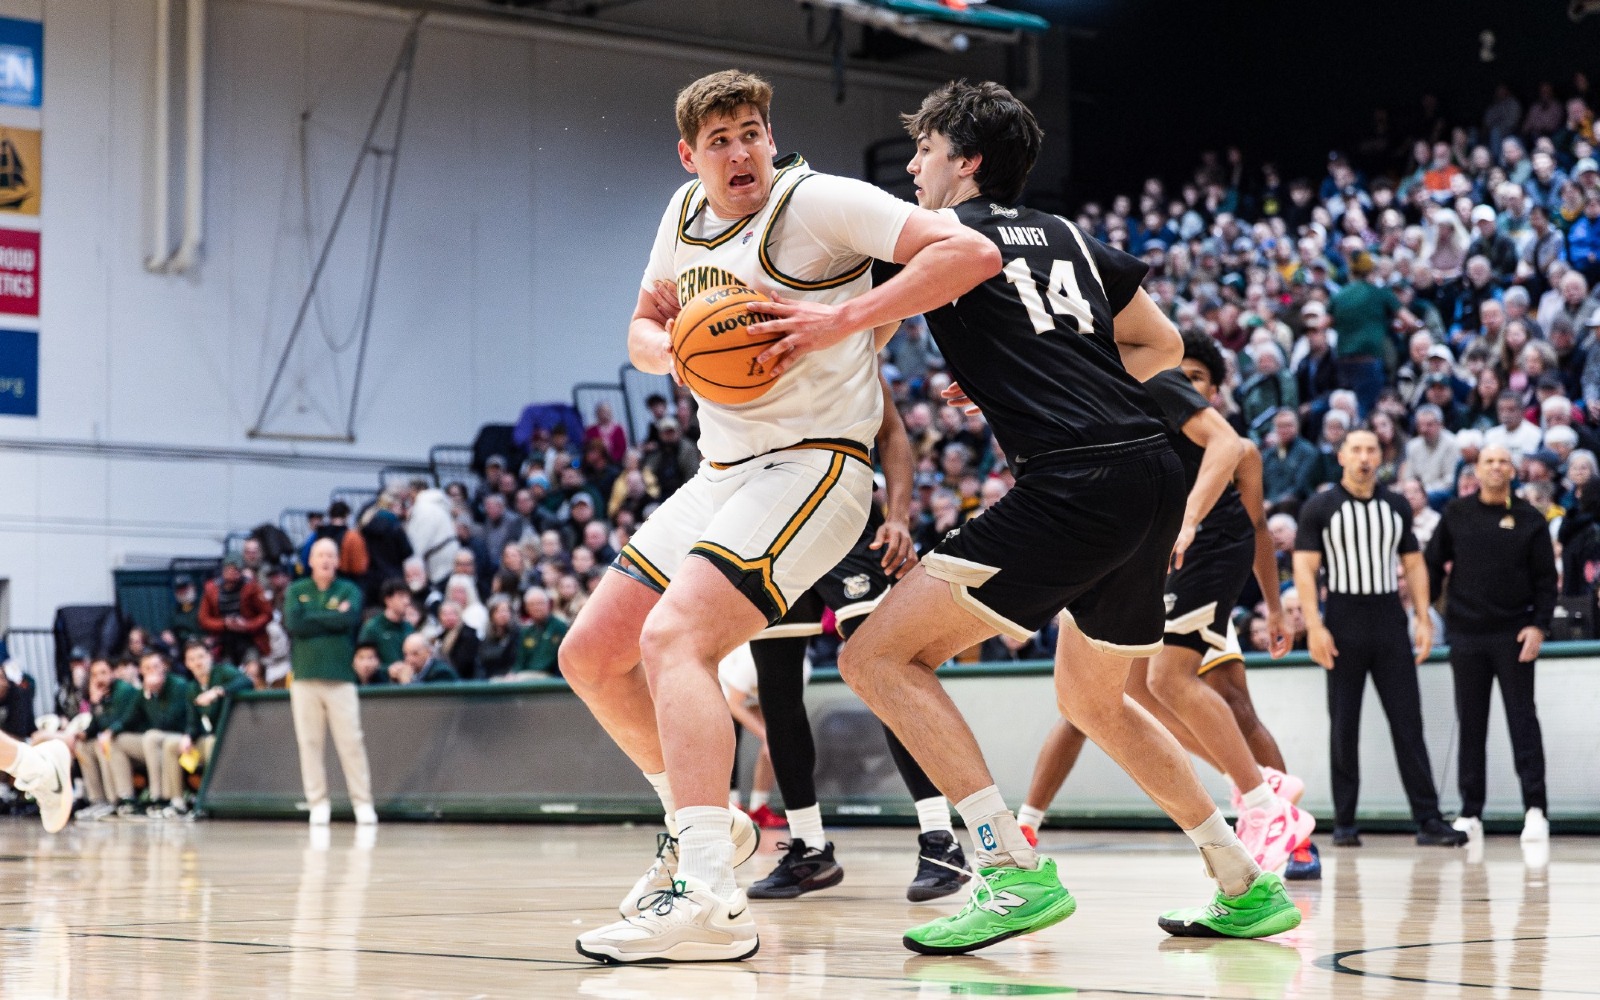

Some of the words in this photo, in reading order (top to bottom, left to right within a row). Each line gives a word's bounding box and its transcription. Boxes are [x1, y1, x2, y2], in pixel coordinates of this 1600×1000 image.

[997, 226, 1048, 246] HARVEY
[677, 265, 748, 306] ERMO
[704, 286, 757, 305] NCAA
[1002, 257, 1094, 335] 14
